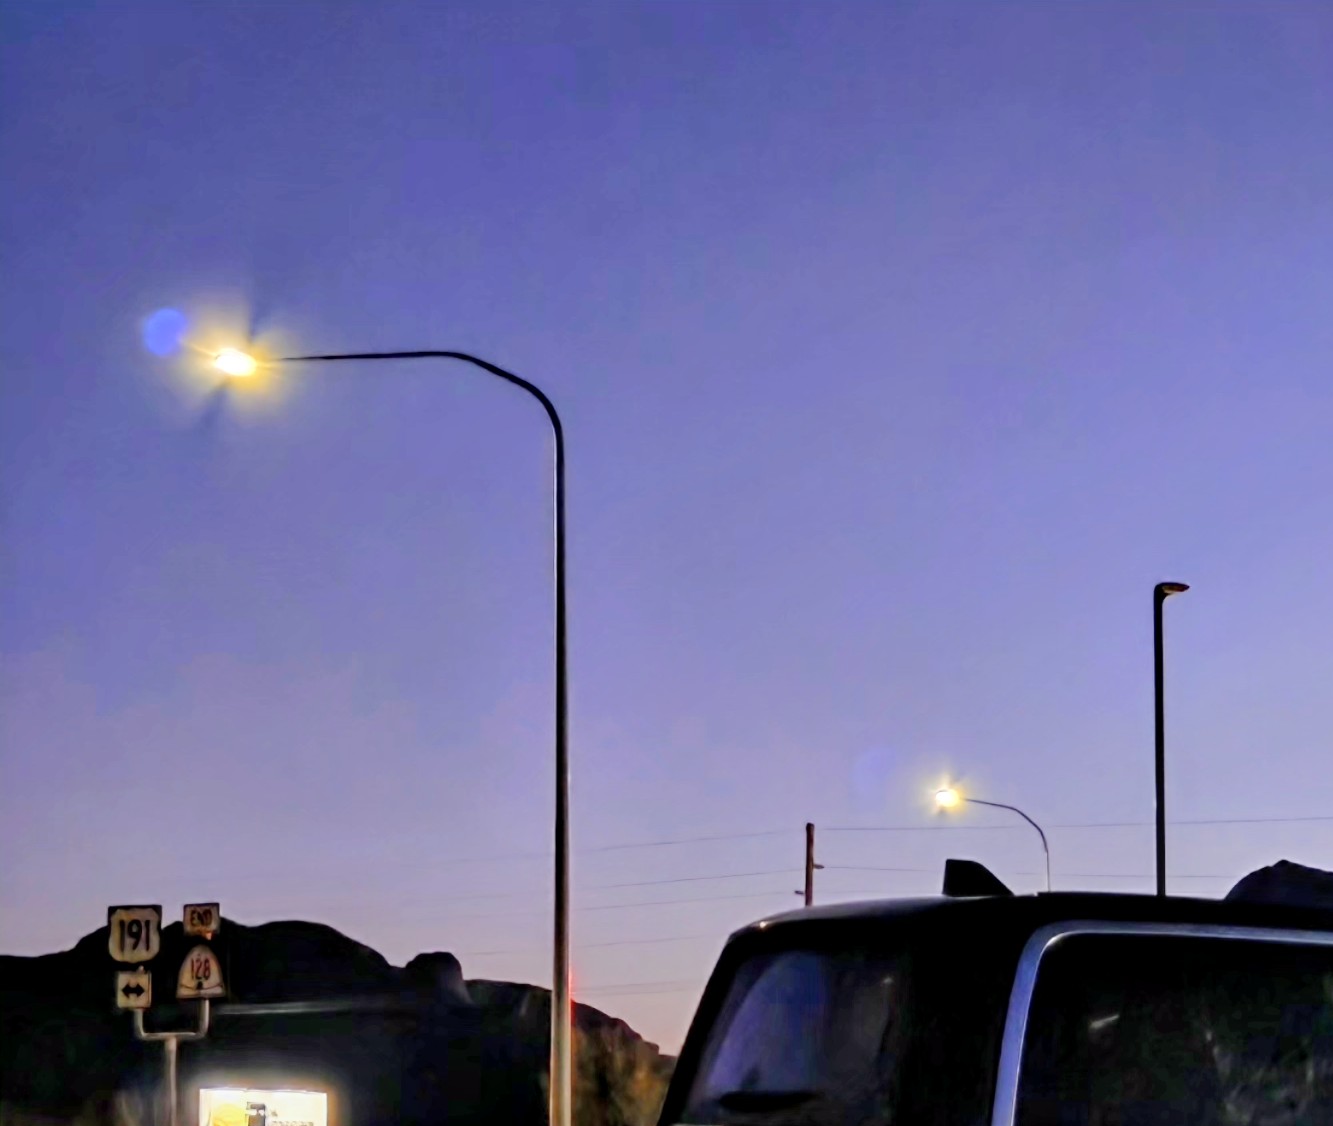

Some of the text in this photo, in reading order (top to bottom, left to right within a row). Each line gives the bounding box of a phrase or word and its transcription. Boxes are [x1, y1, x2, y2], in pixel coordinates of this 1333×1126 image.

[190, 908, 213, 927] END
[118, 919, 151, 952] 191
[190, 957, 212, 981] 128
